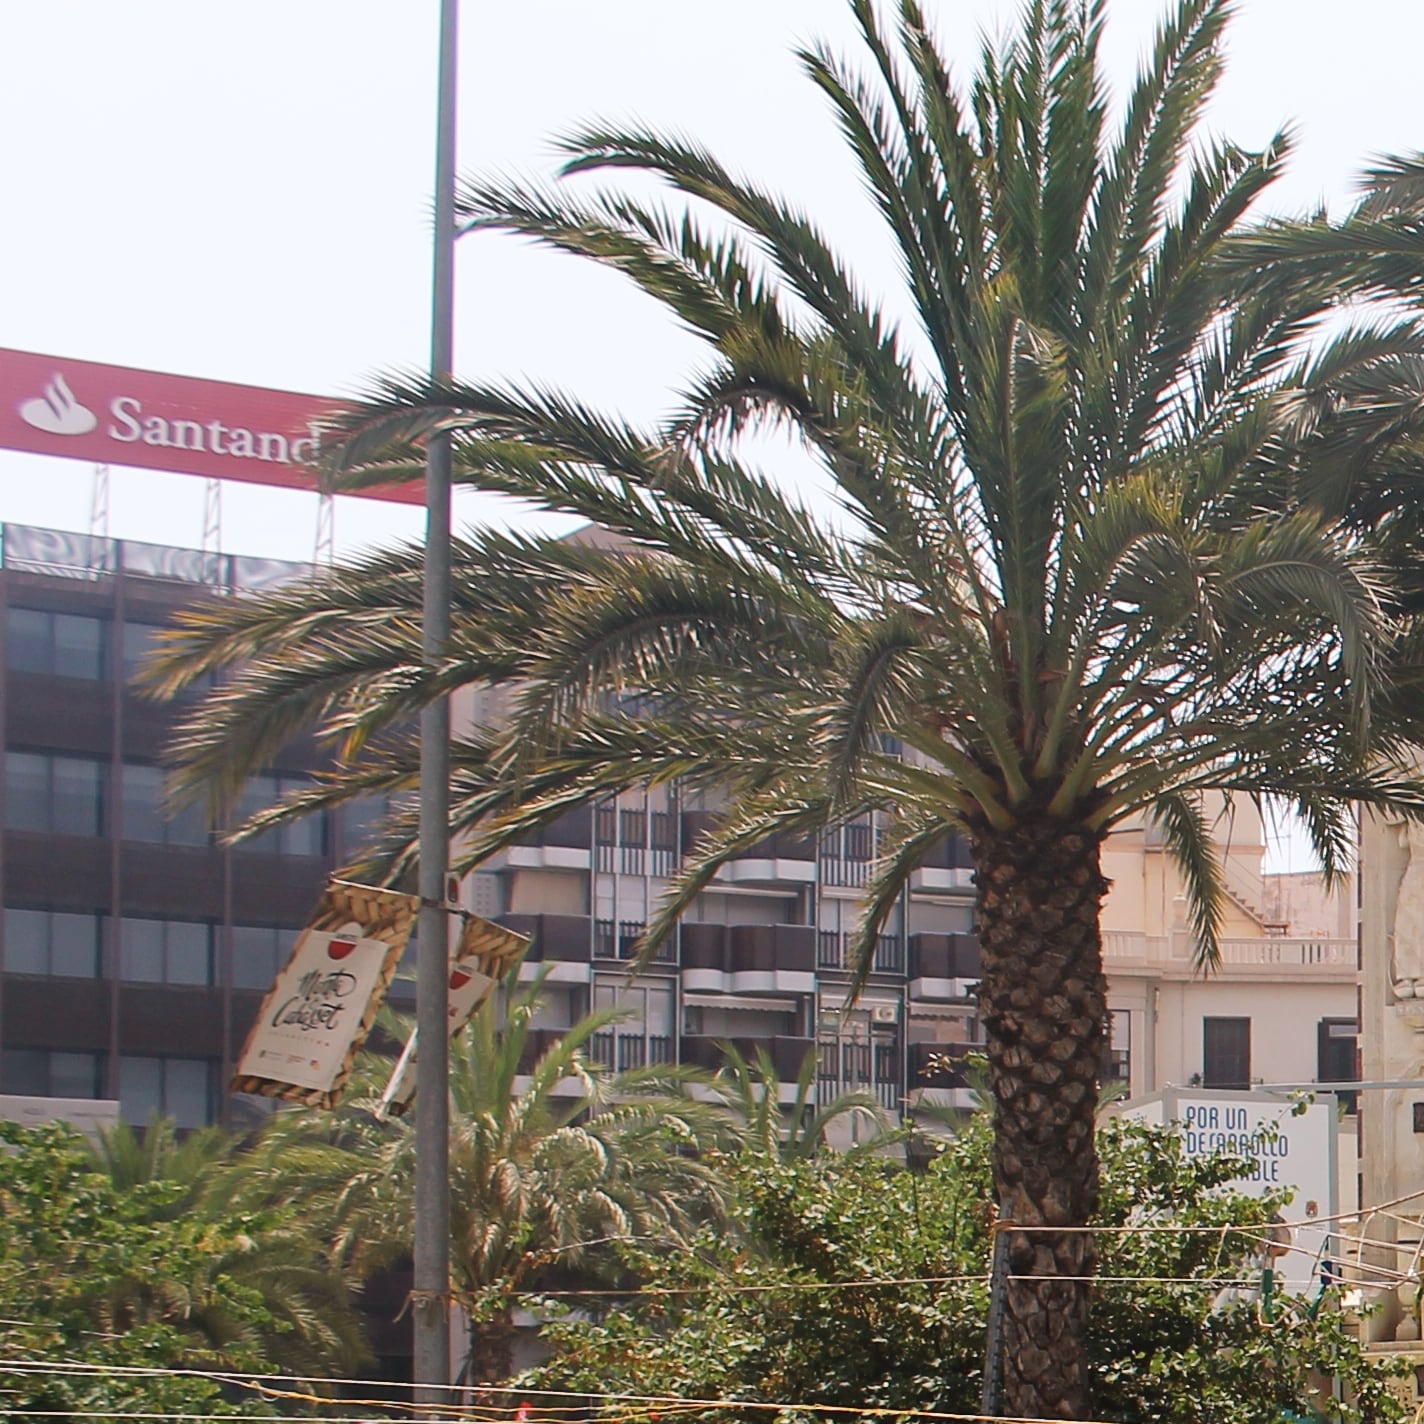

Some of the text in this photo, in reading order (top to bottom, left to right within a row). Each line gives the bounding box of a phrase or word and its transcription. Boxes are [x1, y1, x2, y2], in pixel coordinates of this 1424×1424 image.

[108, 396, 322, 467] Santand
[1186, 1105, 1247, 1131] POR UN
